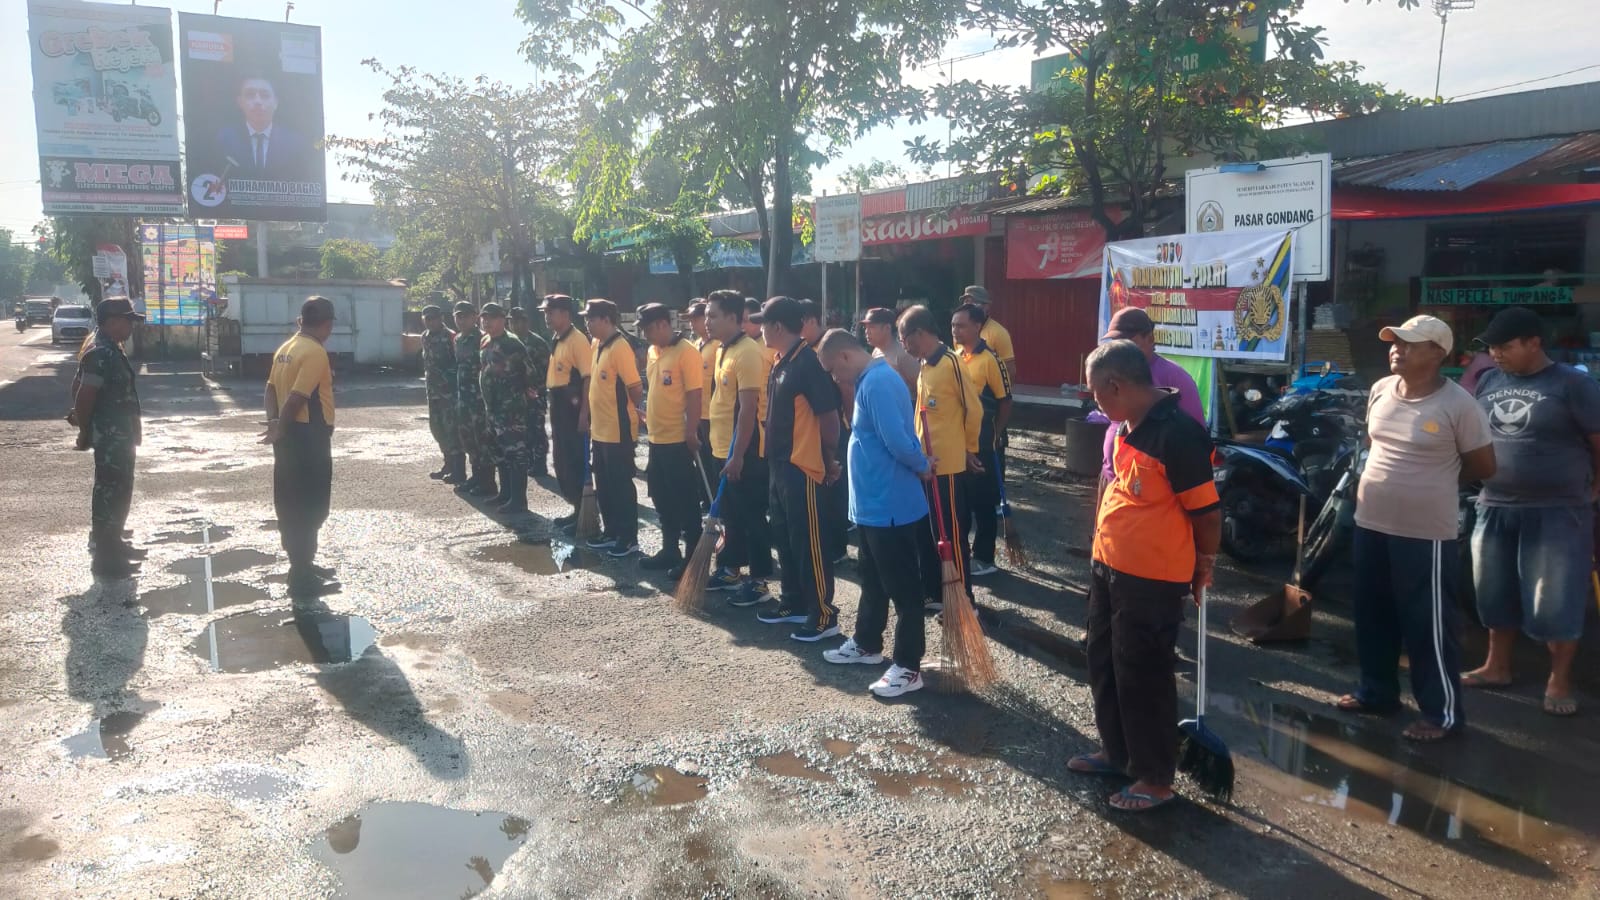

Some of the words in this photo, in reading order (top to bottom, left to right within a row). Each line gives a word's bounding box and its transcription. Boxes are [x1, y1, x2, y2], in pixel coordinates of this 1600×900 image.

[74, 162, 174, 185] MEGA
[202, 180, 216, 200] 2
[228, 179, 288, 193] MUHAMMAD
[1234, 213, 1264, 228] PASAR
[1266, 209, 1314, 225] GONDANG
[1427, 289, 1453, 303] NASI
[1456, 289, 1497, 303] PECEL
[1503, 290, 1557, 302] TUMPANG
